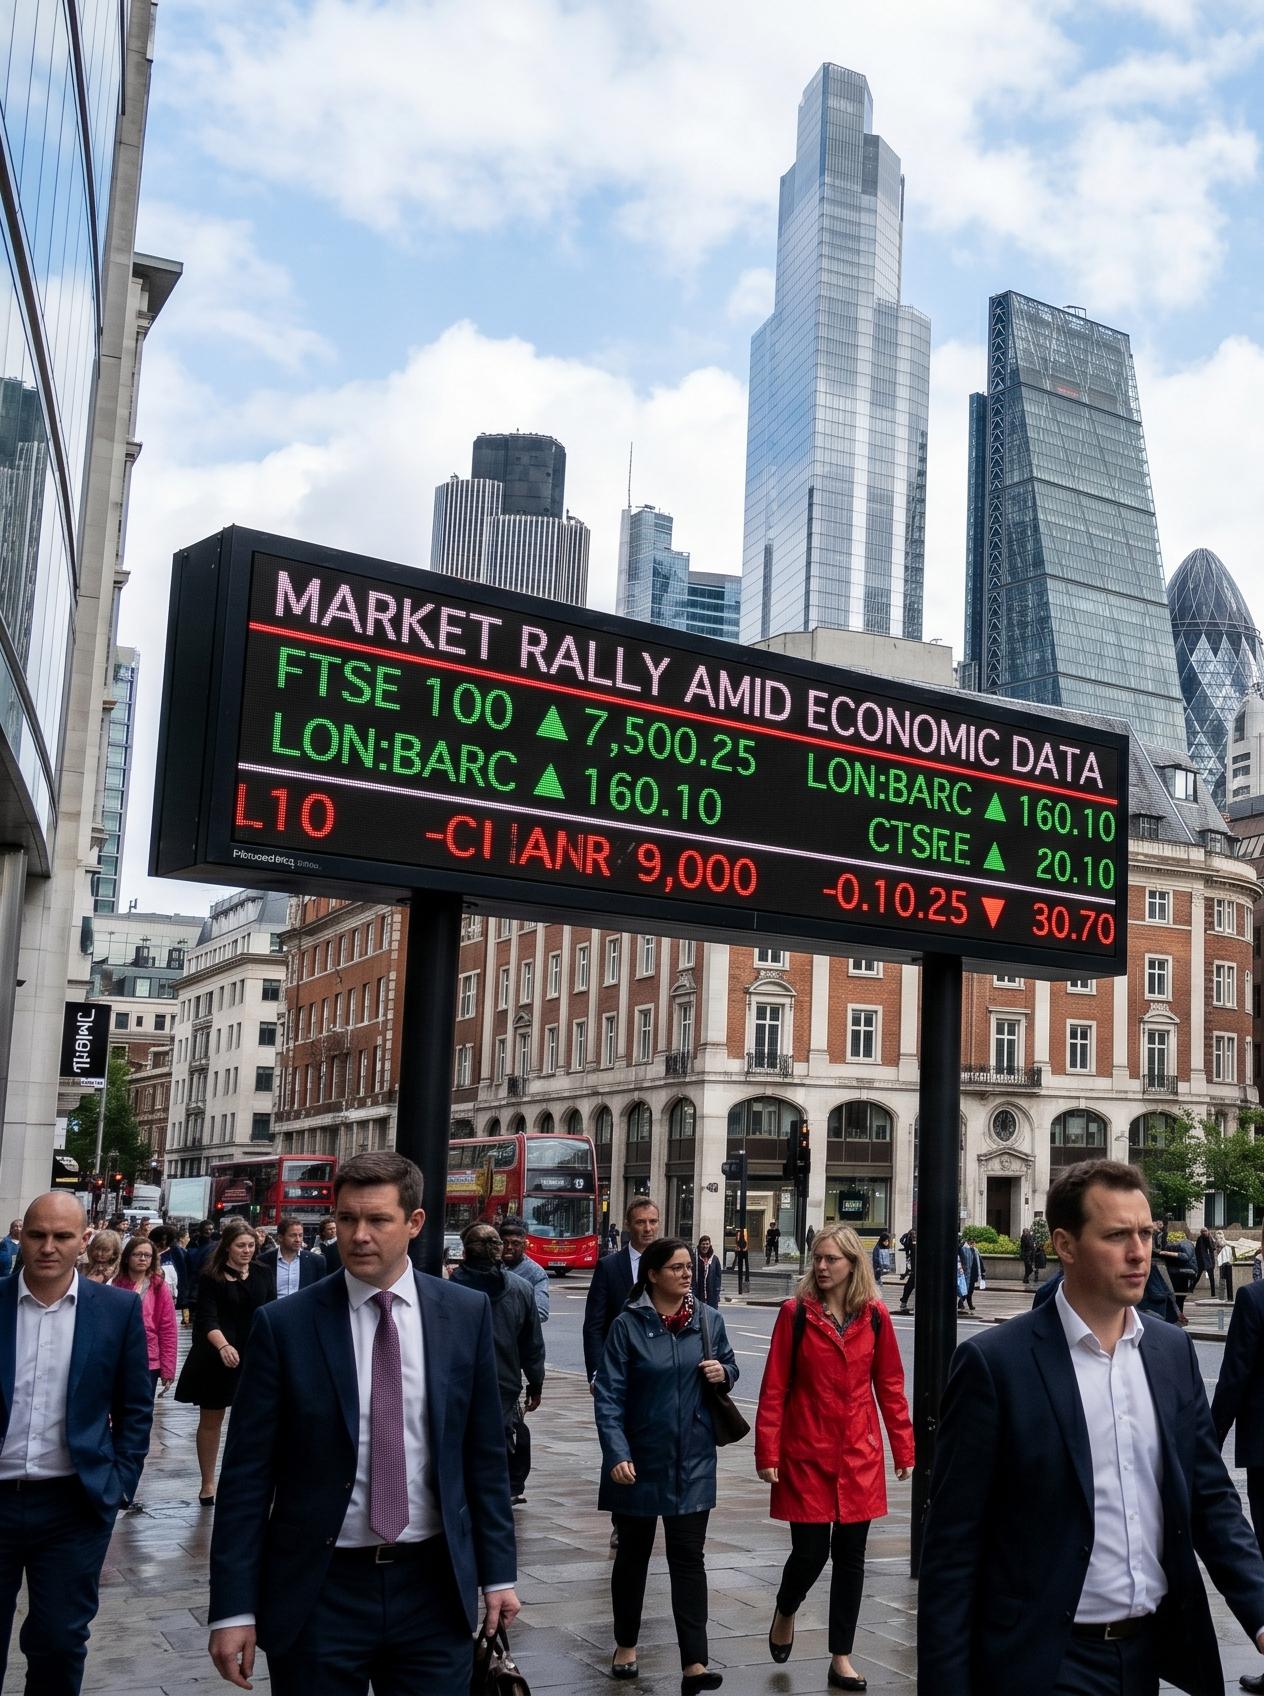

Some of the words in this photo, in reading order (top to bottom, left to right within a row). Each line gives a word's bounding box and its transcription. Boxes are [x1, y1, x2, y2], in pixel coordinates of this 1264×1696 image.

[276, 571, 502, 660] MARKET
[521, 625, 670, 695] RALLY
[684, 665, 791, 721] AMID
[808, 690, 999, 767] ECONOMIC
[1013, 735, 1103, 788] DATA
[278, 647, 401, 710] FTSE
[427, 678, 513, 730] 100
[585, 708, 756, 776] 7,500.25
[272, 712, 517, 791] LON:BARC
[585, 768, 722, 825] 160.10
[808, 753, 972, 815] LON:BARC
[1020, 796, 1116, 842] 160.10
[236, 784, 334, 837] L10
[638, 843, 757, 896] 9,000
[1037, 848, 1115, 890] 20.10
[822, 874, 968, 924] -0.10.25
[1033, 903, 1115, 944] 30.70
